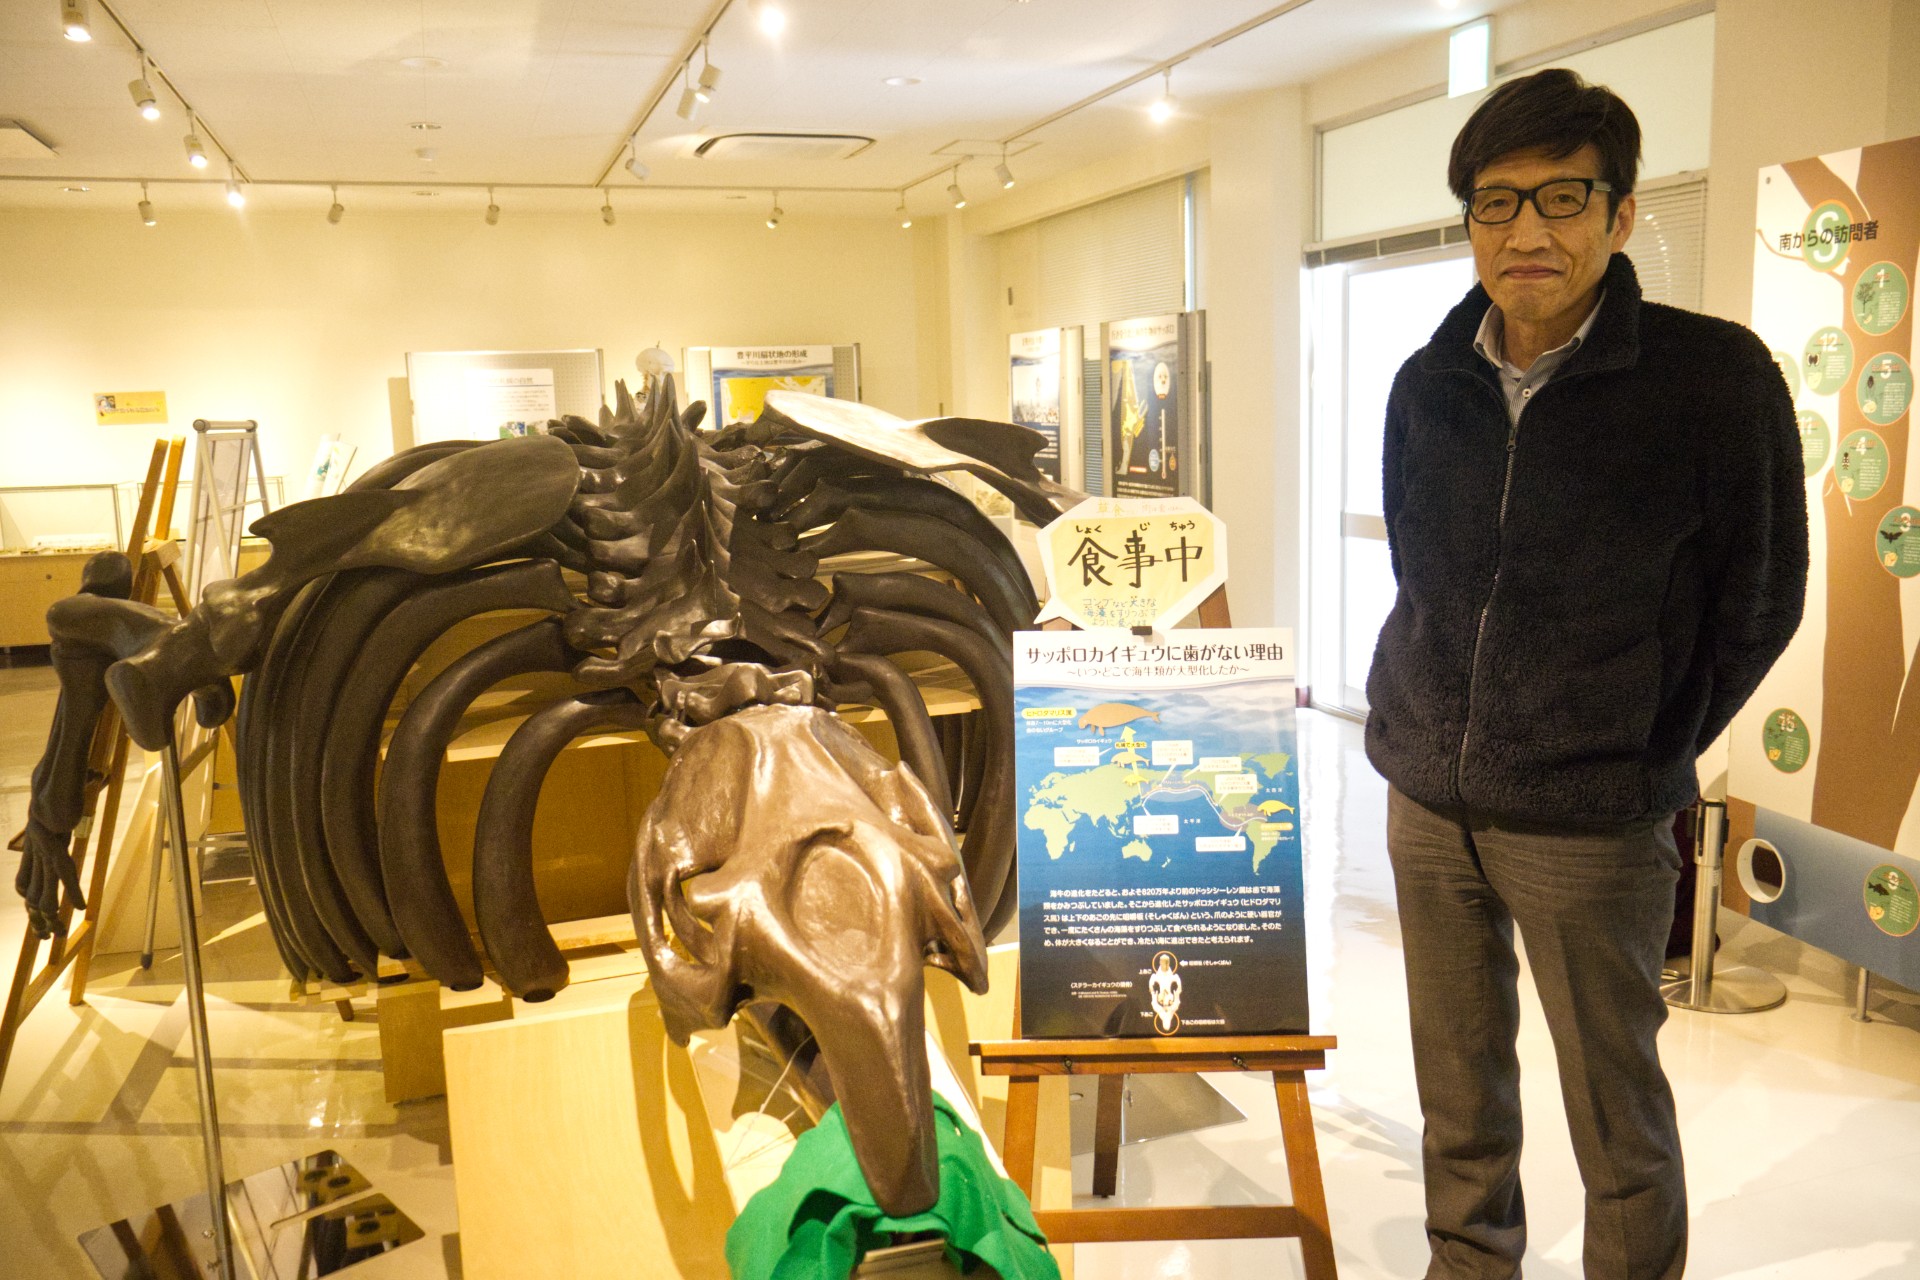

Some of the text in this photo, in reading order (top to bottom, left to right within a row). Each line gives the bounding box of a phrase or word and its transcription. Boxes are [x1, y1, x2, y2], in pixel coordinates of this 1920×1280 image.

[1778, 219, 1879, 252] 南からの訪問者
[1812, 210, 1840, 263] S
[1819, 332, 1839, 352] 12
[1880, 359, 1892, 379] 5
[1855, 436, 1867, 456] 4
[1075, 520, 1196, 534] しょく じ ちゅう
[1067, 530, 1203, 589] 食事中
[1026, 643, 1283, 664] サッポロカイギュウに歯がない理由
